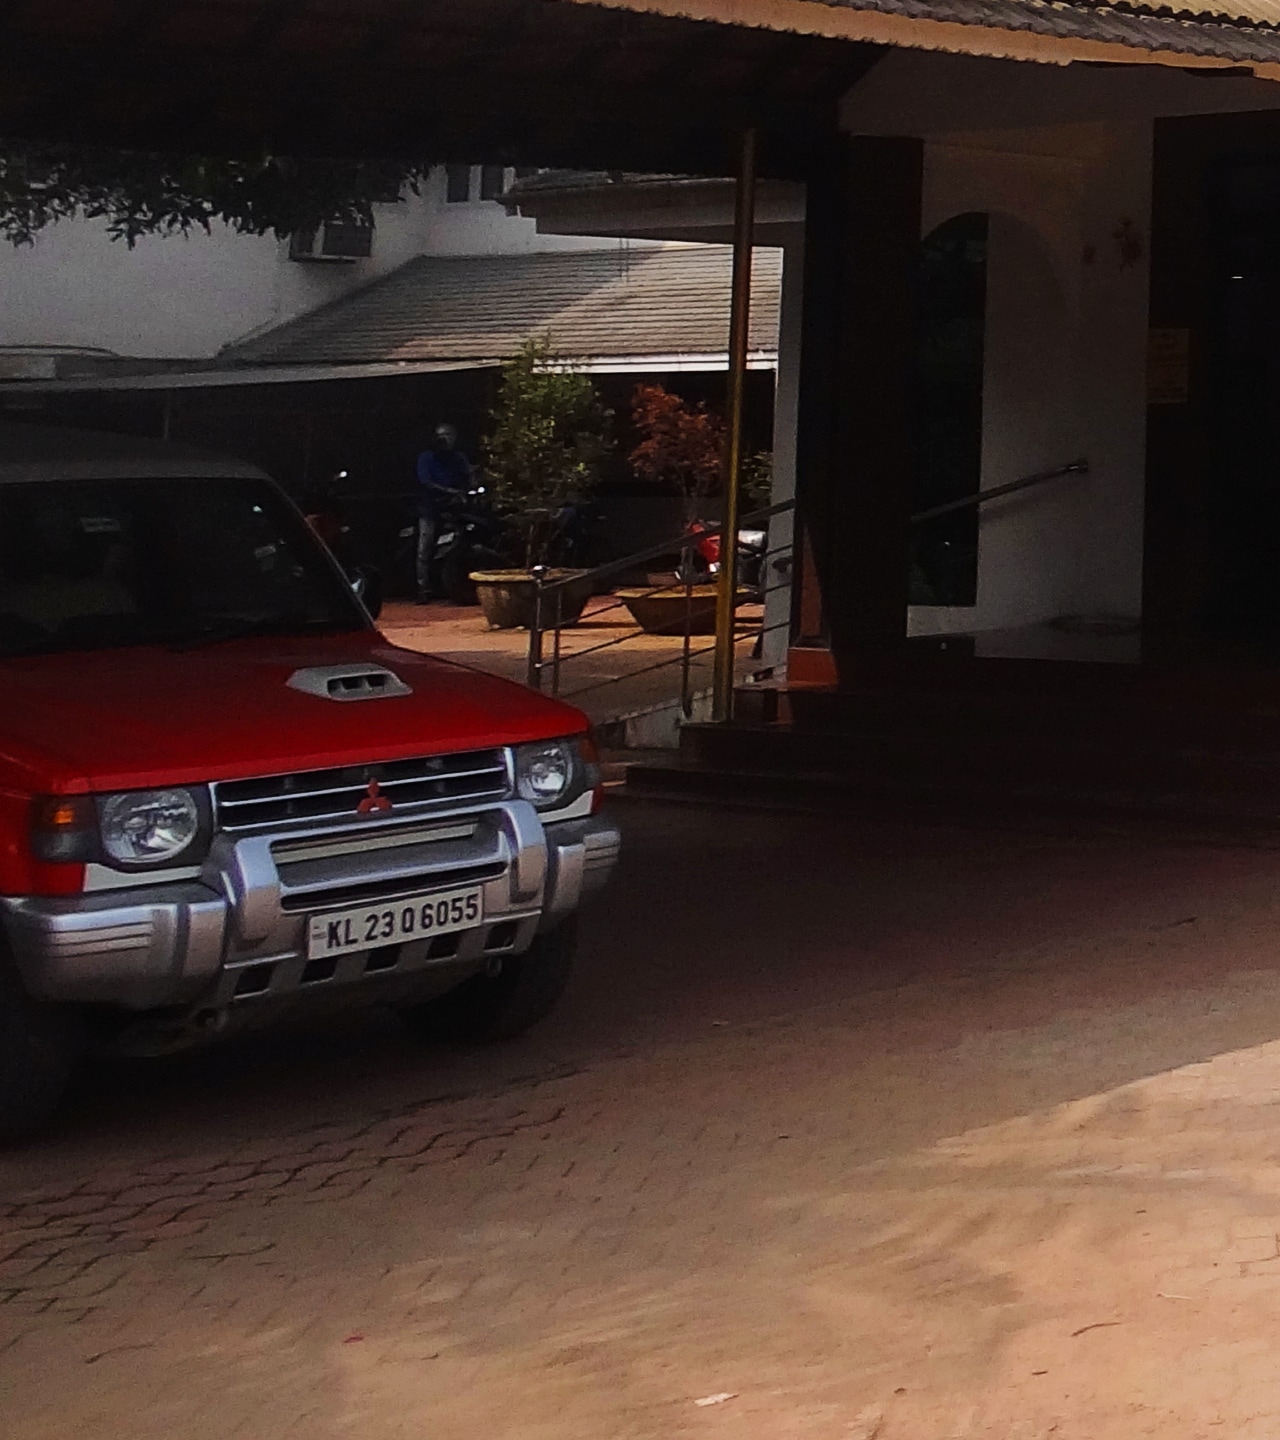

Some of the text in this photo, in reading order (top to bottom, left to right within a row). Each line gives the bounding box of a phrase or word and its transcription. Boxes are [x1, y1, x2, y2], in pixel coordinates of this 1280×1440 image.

[326, 918, 358, 949] KL
[364, 910, 396, 942] 23
[420, 892, 479, 930] 6055
